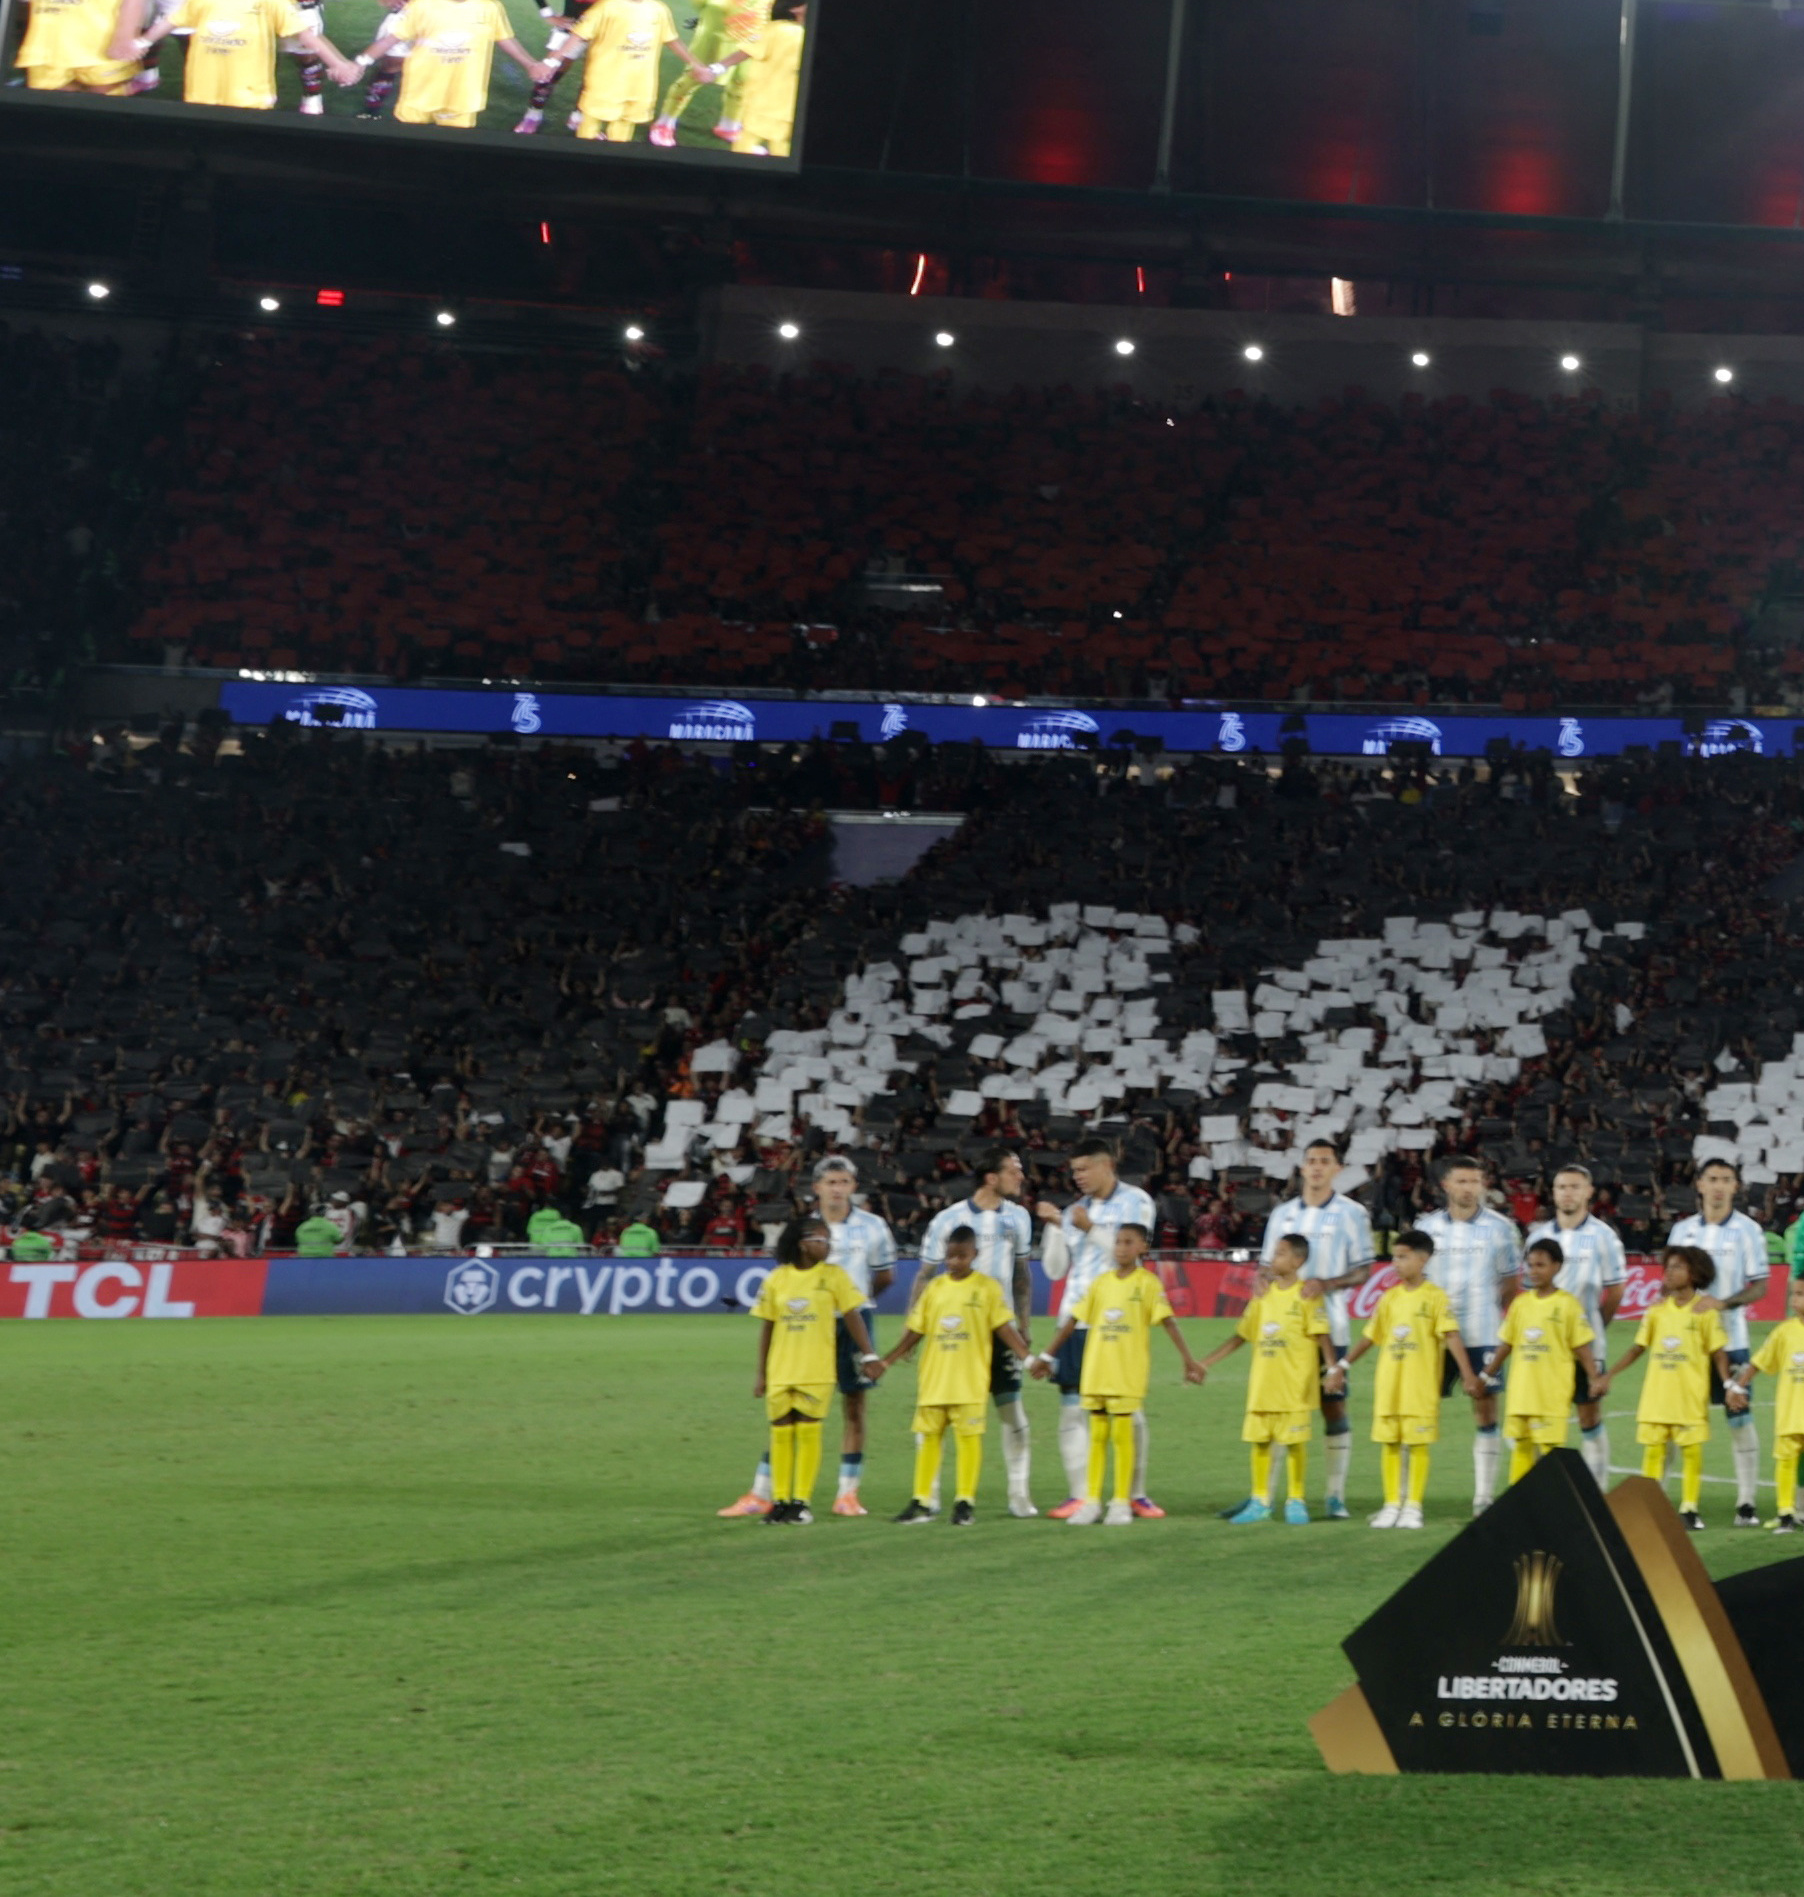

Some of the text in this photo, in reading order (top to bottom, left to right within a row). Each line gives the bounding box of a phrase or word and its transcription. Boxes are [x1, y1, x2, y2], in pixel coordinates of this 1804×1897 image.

[9, 1261, 196, 1318] TCL
[1437, 1676, 1619, 1701] LIBERTADORES
[1408, 1712, 1424, 1727] A
[1547, 1712, 1639, 1730] ETERNA
